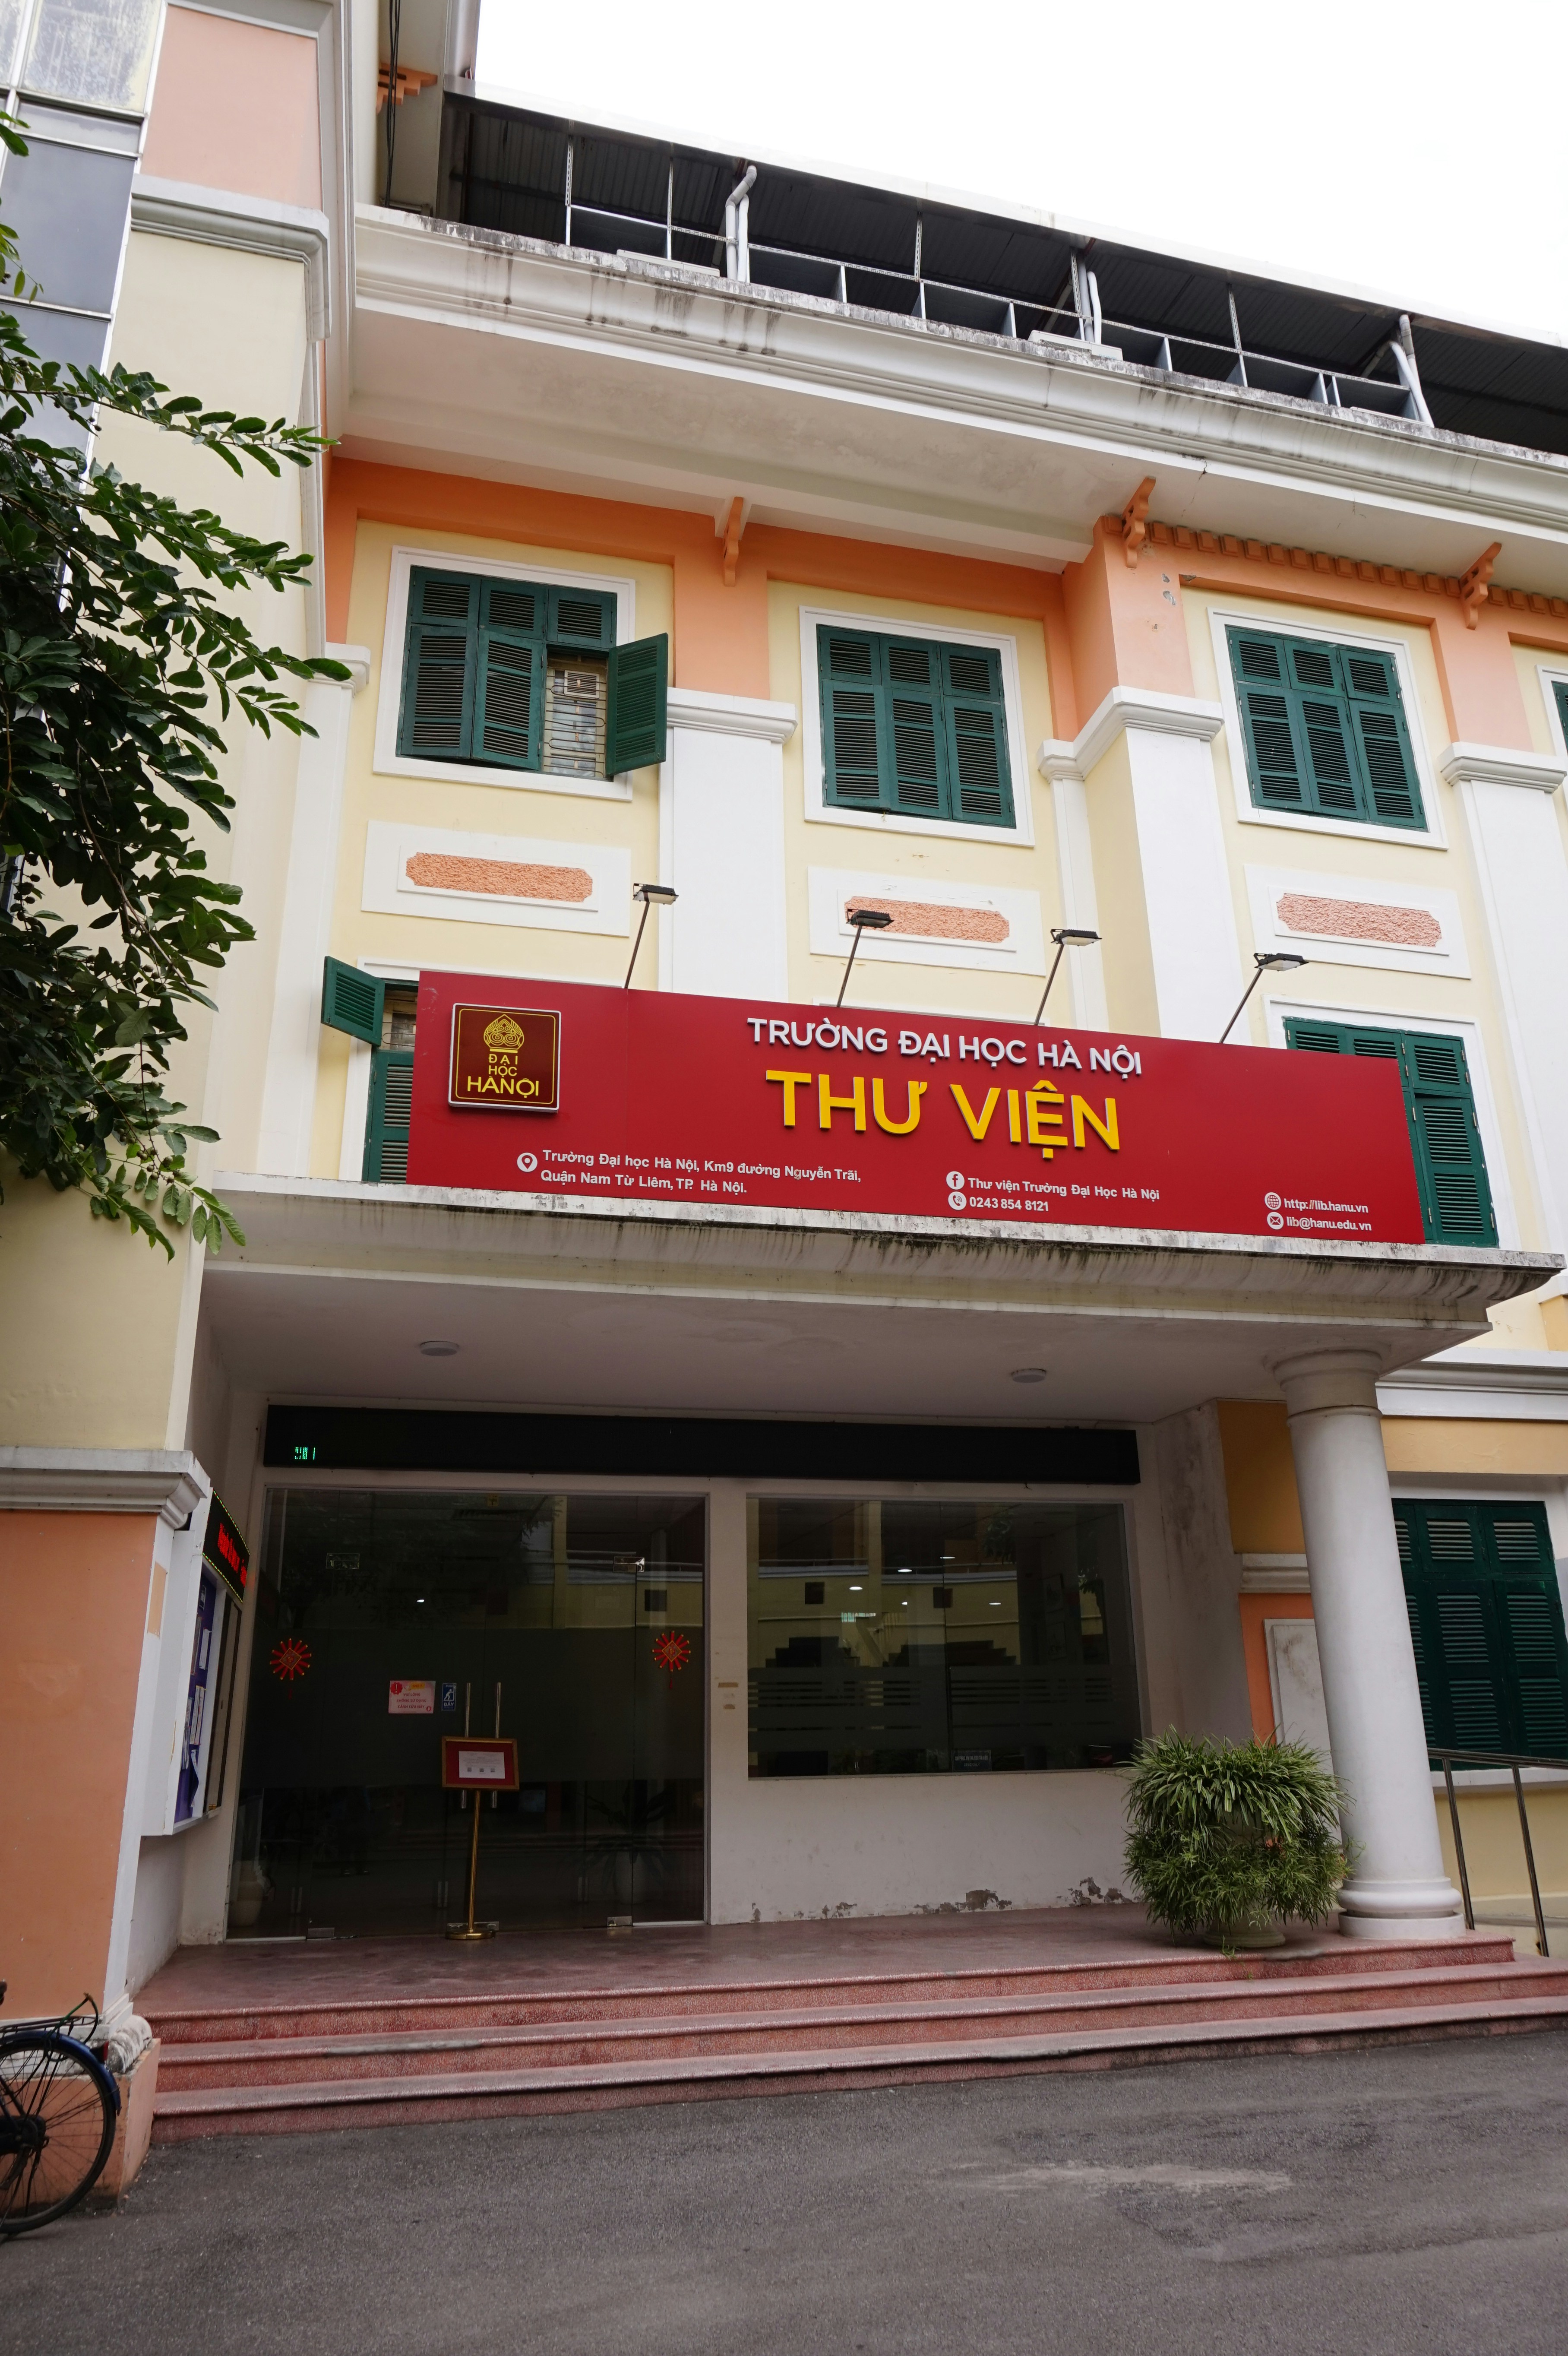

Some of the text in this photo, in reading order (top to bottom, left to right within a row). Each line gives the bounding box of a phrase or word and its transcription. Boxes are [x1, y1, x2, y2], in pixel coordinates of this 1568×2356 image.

[488, 1054, 518, 1066] ĐẠI
[747, 1017, 1142, 1080] TRƯỜNG ĐẠI HỌC HÀ NỘI
[488, 1065, 518, 1077] HỌC
[766, 1069, 1120, 1159] THƯ VIỆN
[542, 1150, 861, 1183] Trường Đại học Hà Nội, Km9 đường Nguyễn Trãi,
[541, 1169, 747, 1195] Quận Nam Từ Liêm, TP. Hà Nội.
[967, 1178, 993, 1189] Thư
[995, 1180, 1020, 1193] viện
[1022, 1181, 1067, 1197] Trường
[1071, 1184, 1090, 1198] Đại
[1095, 1186, 1118, 1199] Học
[1122, 1188, 1138, 1199] Hà
[1141, 1189, 1160, 1202] Nội
[969, 1197, 1049, 1212] 0243 854 8121
[1284, 1198, 1369, 1213] http://lib.hanu.vn
